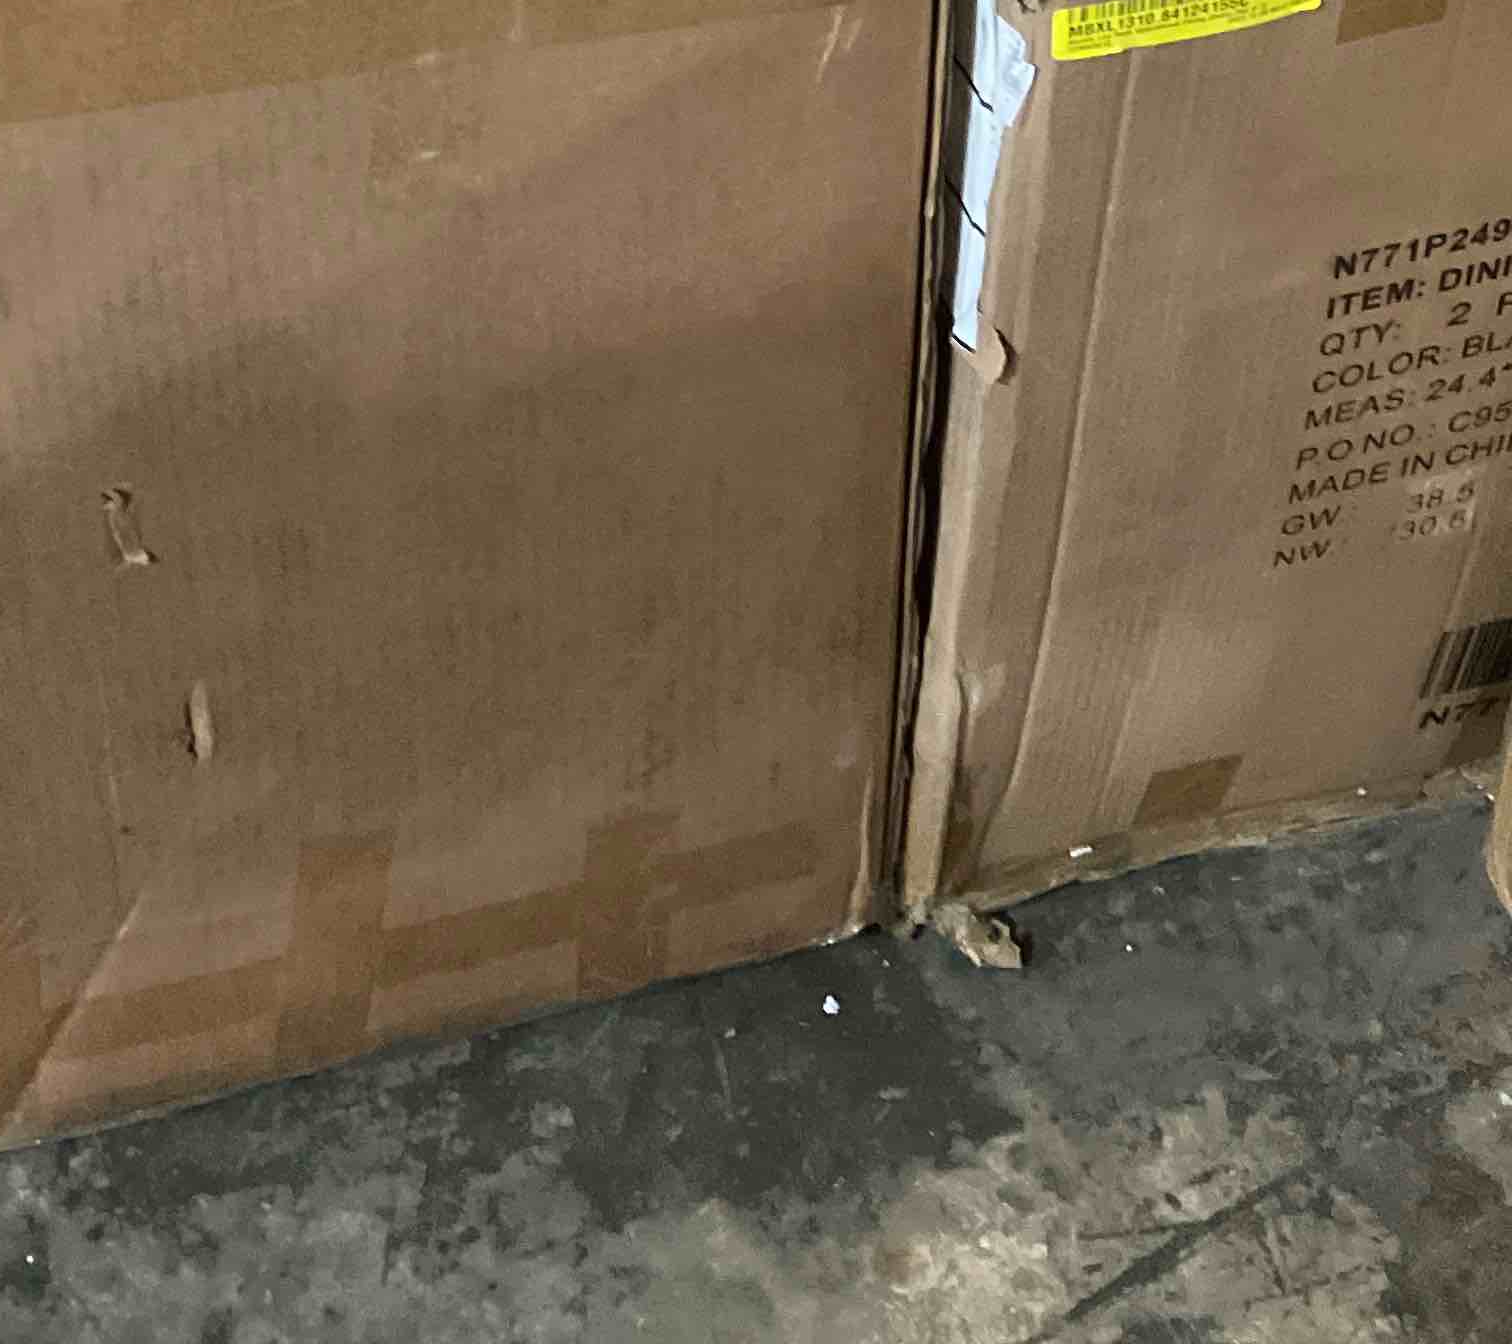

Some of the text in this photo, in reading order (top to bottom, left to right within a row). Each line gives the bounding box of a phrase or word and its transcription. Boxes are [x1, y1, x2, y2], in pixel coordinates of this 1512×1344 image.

[1333, 217, 1512, 280] N771P249
[1326, 278, 1426, 320] ITEM:
[1447, 301, 1472, 327] 2
[1312, 344, 1452, 394] COLOR:
[1289, 461, 1391, 506] MADE
[1400, 450, 1435, 479] IN
